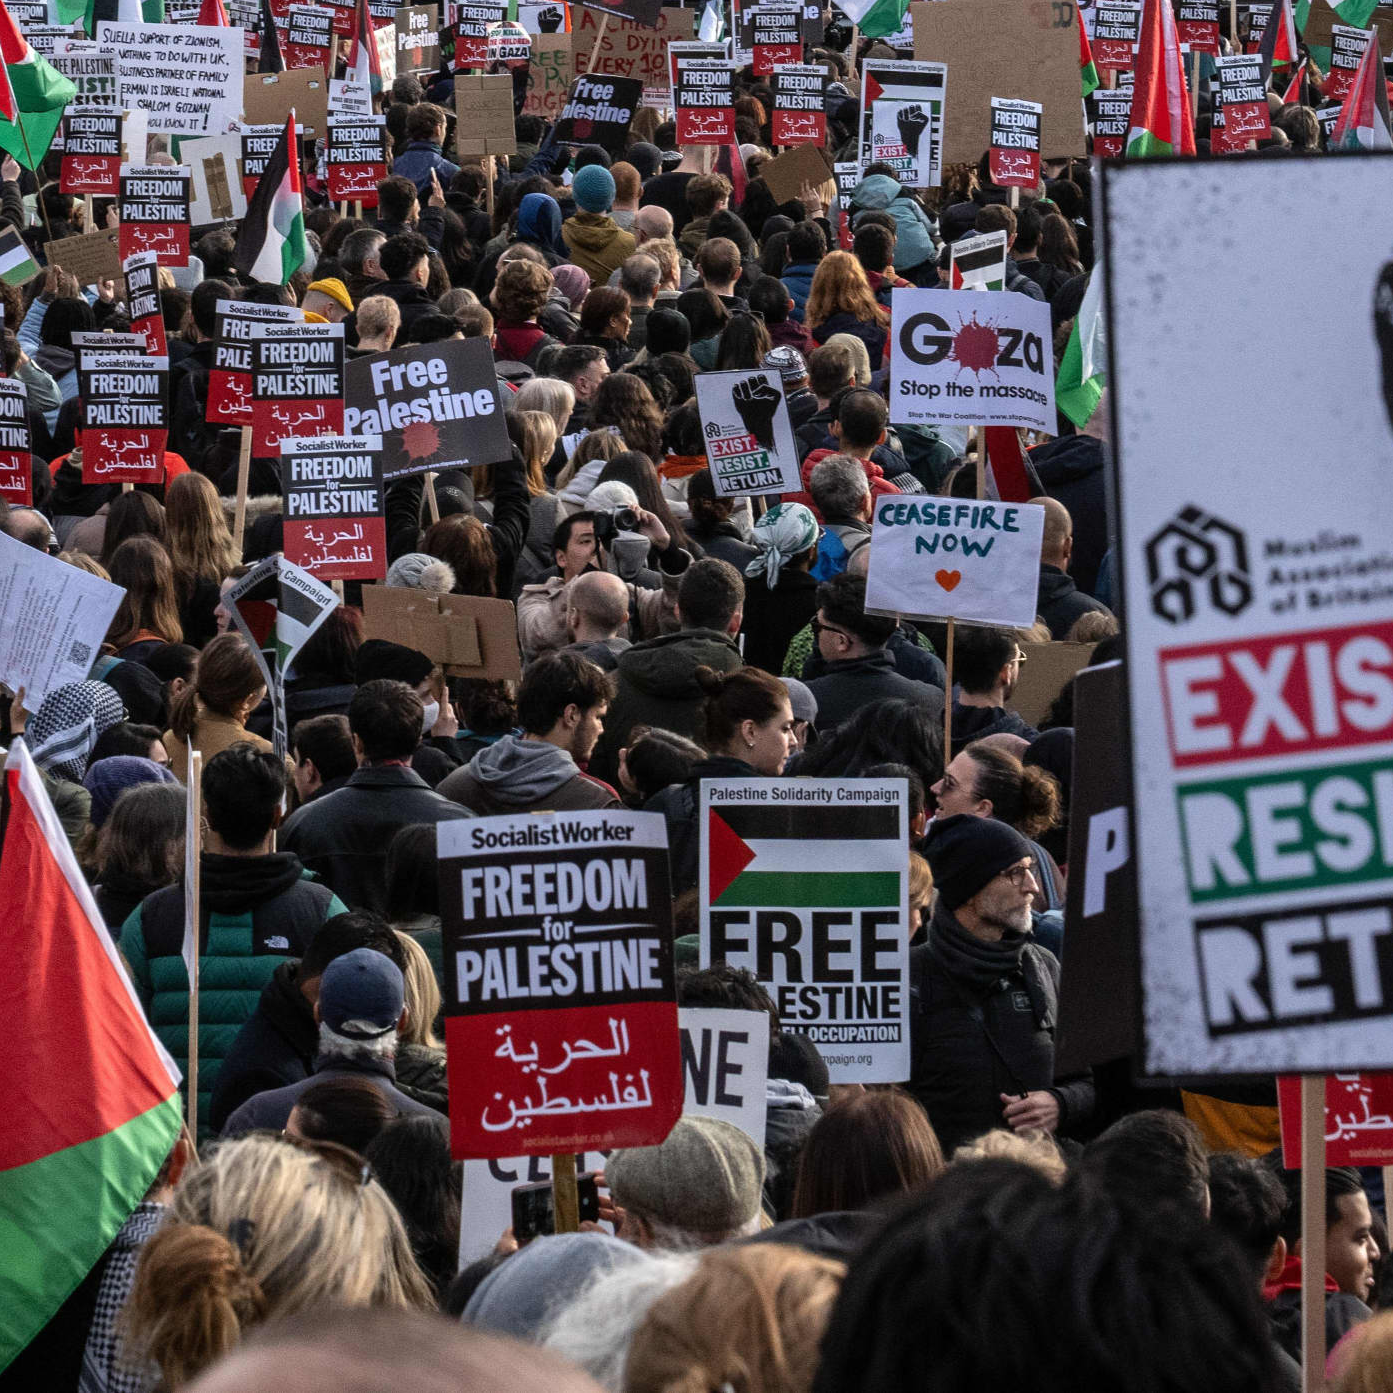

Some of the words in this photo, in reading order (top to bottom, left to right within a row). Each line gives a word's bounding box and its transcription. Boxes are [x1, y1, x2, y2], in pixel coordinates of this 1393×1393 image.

[103, 28, 136, 44] SUELLA
[172, 34, 183, 45] OF
[575, 53, 636, 75] EVERY
[899, 312, 1045, 376] Gza
[90, 374, 159, 396] FREEDOM
[370, 358, 447, 396] Free
[899, 380, 942, 401] Stop
[945, 379, 975, 399] the
[977, 384, 1047, 406] massacre
[86, 404, 163, 426] PALESTINE
[343, 387, 496, 436] Palestine
[99, 433, 149, 453] الحرية
[710, 437, 757, 457] EXIST.
[94, 454, 157, 475] لفلسطين
[291, 456, 373, 481] FREEDOM
[715, 454, 769, 475] RESIST.
[325, 480, 340, 491] for
[720, 470, 783, 492] RETURN.
[288, 489, 379, 516] PALESTINE
[877, 502, 1019, 533] CEASEFIRE
[304, 523, 364, 543] الحرية
[913, 533, 995, 558] NOW
[1264, 532, 1361, 558] Muslim
[299, 545, 374, 569] لفلسطين
[709, 786, 769, 801] Palestine
[772, 786, 834, 804] Solidarity
[836, 787, 901, 804] Campaign
[460, 857, 648, 921] FREEDOM
[541, 915, 574, 943] for
[709, 910, 901, 984] FREE
[454, 937, 664, 1004] PALESTINE
[779, 986, 901, 1024] ESTINE
[493, 1017, 630, 1075] الحرية
[809, 1024, 900, 1044] OCCUPATION
[479, 1068, 654, 1134] لفلسطين
